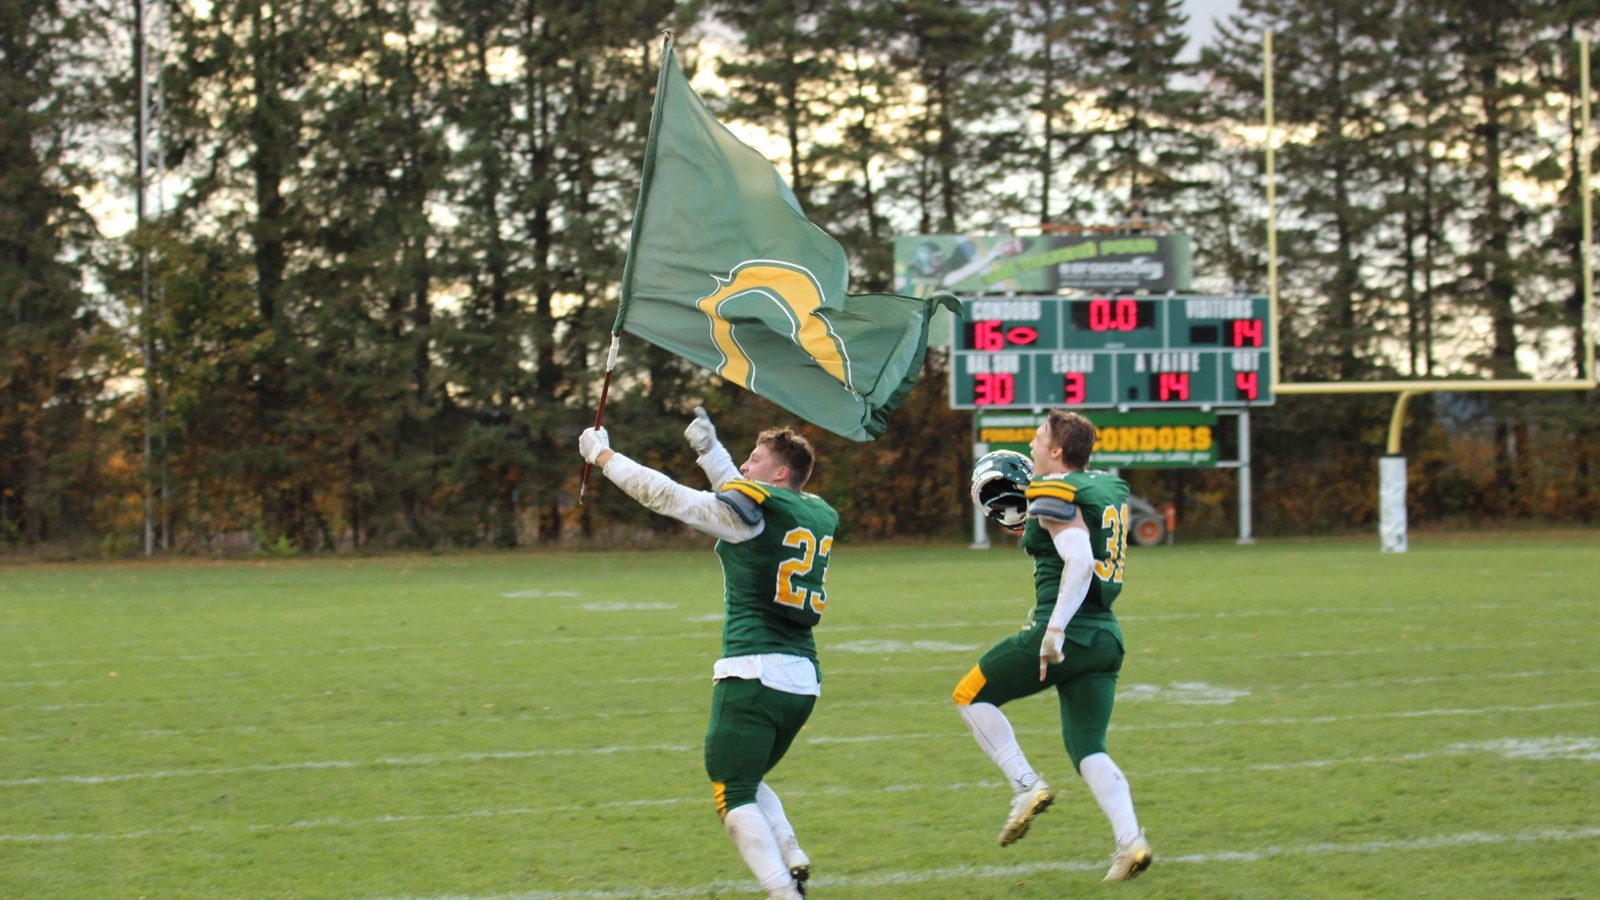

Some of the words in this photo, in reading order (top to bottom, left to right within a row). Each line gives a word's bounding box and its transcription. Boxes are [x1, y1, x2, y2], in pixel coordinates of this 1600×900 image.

[1089, 298, 1137, 331] 0.0
[974, 319, 1004, 351] 16
[1233, 319, 1262, 348] 14
[974, 372, 1014, 405] 30
[1065, 372, 1085, 405] 3
[1159, 372, 1189, 401] 14
[1235, 371, 1258, 400] 4
[1093, 504, 1128, 583] 31
[774, 527, 833, 614] 23
